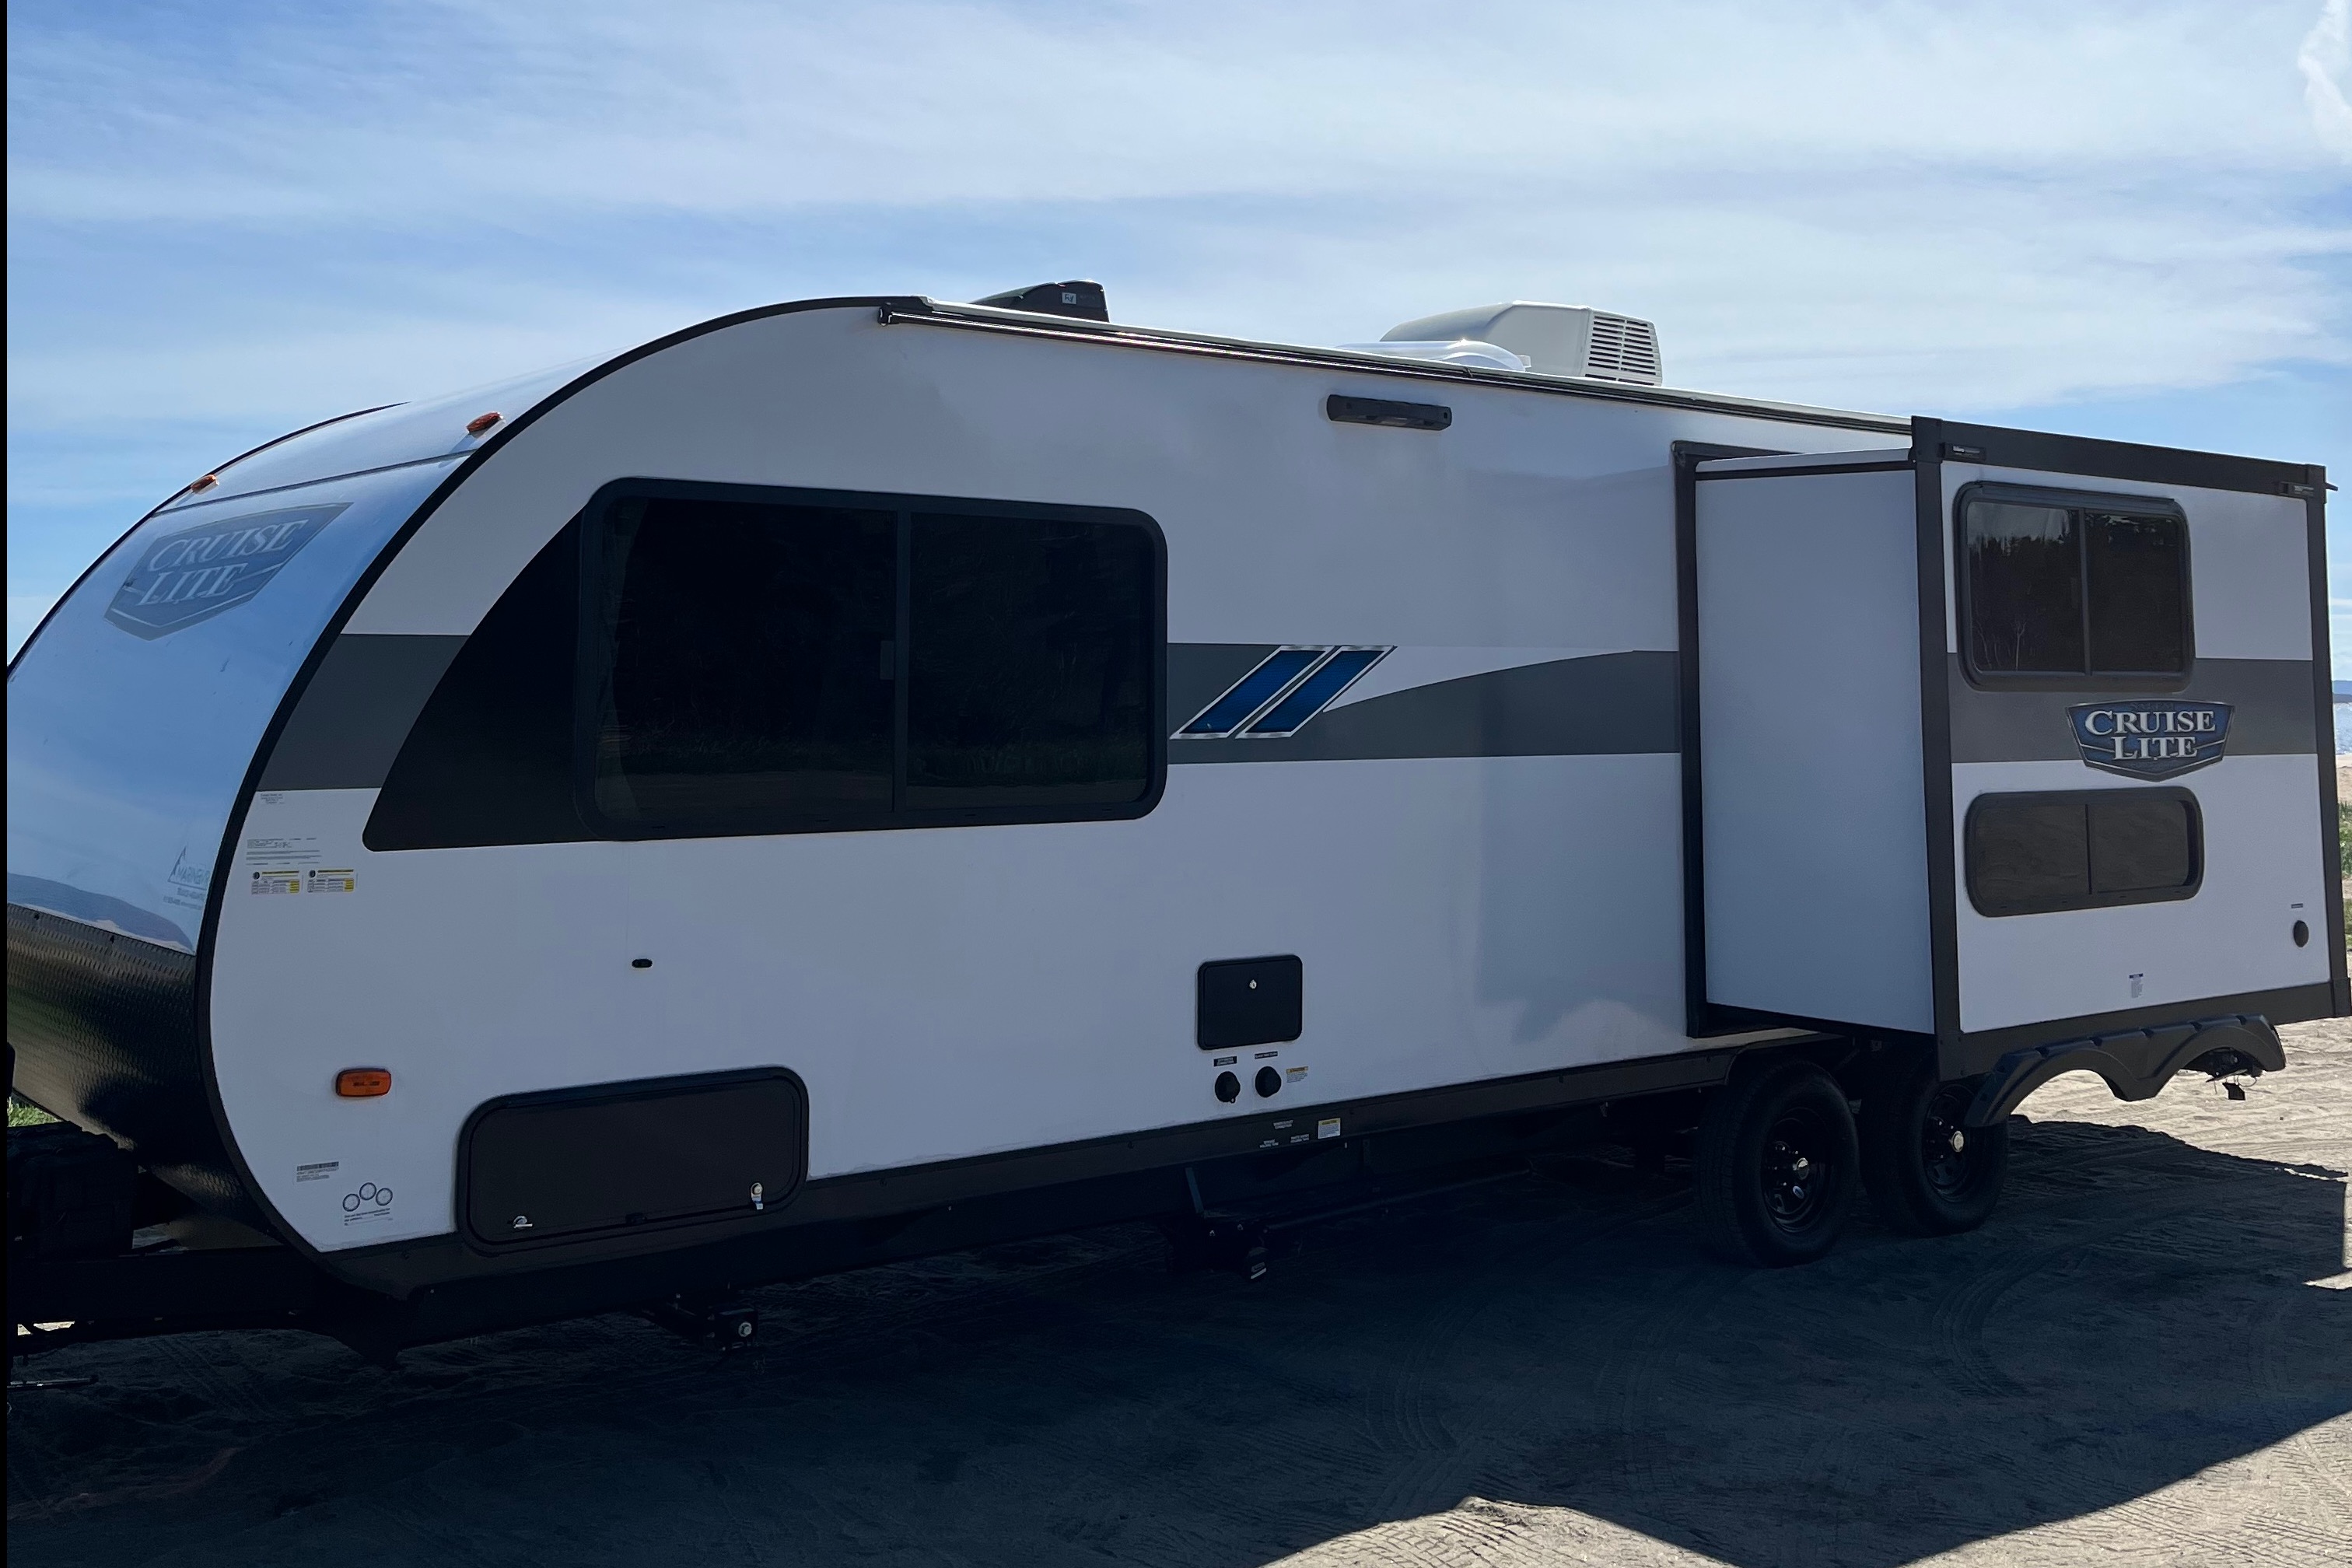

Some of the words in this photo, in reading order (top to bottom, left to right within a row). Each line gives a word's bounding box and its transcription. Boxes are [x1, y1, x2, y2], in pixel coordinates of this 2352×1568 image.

[147, 519, 309, 572] CRUISE
[136, 562, 248, 606] LITE
[2084, 710, 2216, 735] CRUISE
[2110, 736, 2198, 760] LITE
